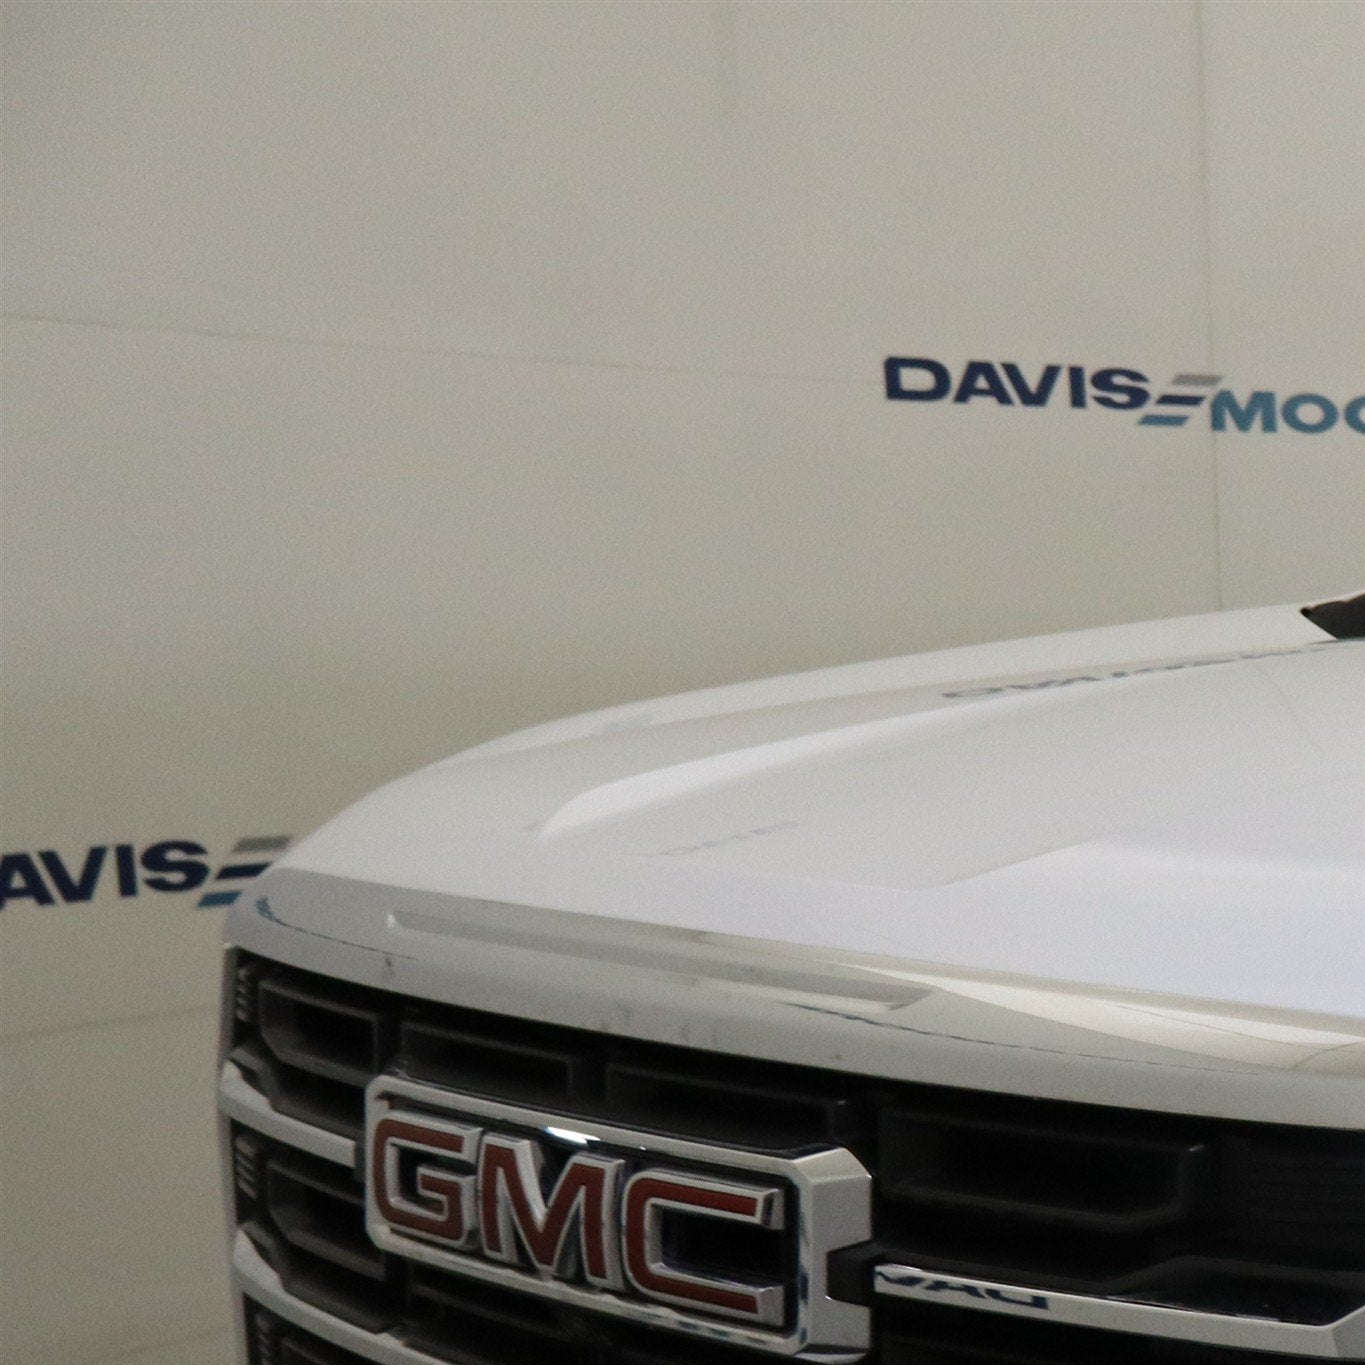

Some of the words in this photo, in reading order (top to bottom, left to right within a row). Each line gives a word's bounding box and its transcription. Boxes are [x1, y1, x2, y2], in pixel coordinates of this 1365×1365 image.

[883, 356, 1150, 411] DAVIS
[0, 839, 209, 911] AVIS
[371, 1104, 786, 1326] GMC
